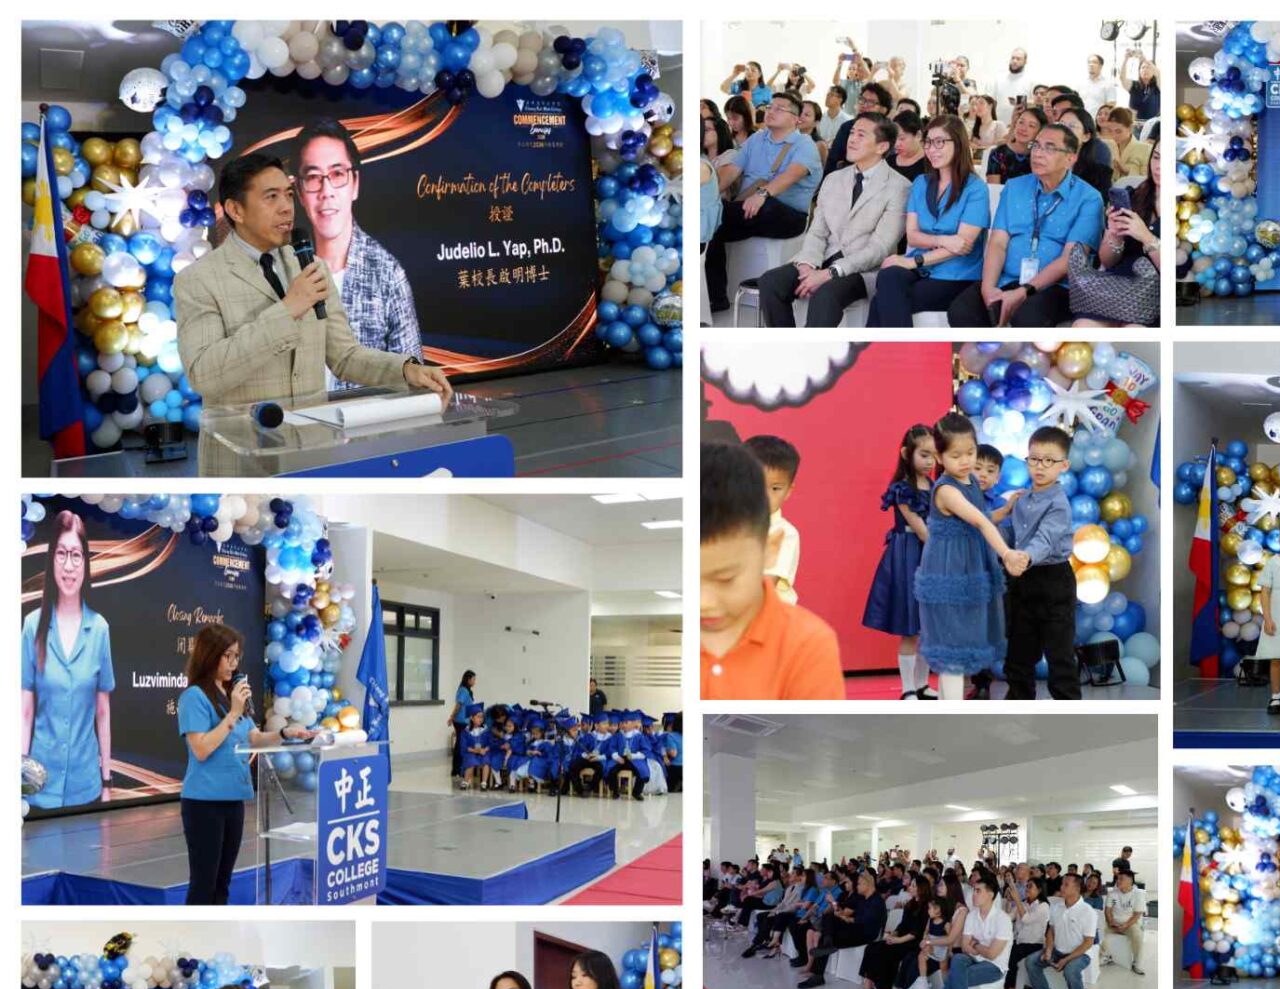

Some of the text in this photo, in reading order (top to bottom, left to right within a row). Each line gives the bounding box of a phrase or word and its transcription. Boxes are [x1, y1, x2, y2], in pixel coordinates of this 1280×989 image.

[417, 172, 576, 200] Confirmation of the Completers
[437, 237, 565, 261] Judelio L. Yap, Ph.D.
[132, 672, 188, 688] Luzviminda
[333, 765, 375, 814] 中正
[326, 818, 380, 866] CKS
[327, 858, 380, 888] COLLEGE
[327, 877, 380, 902] Southmont
